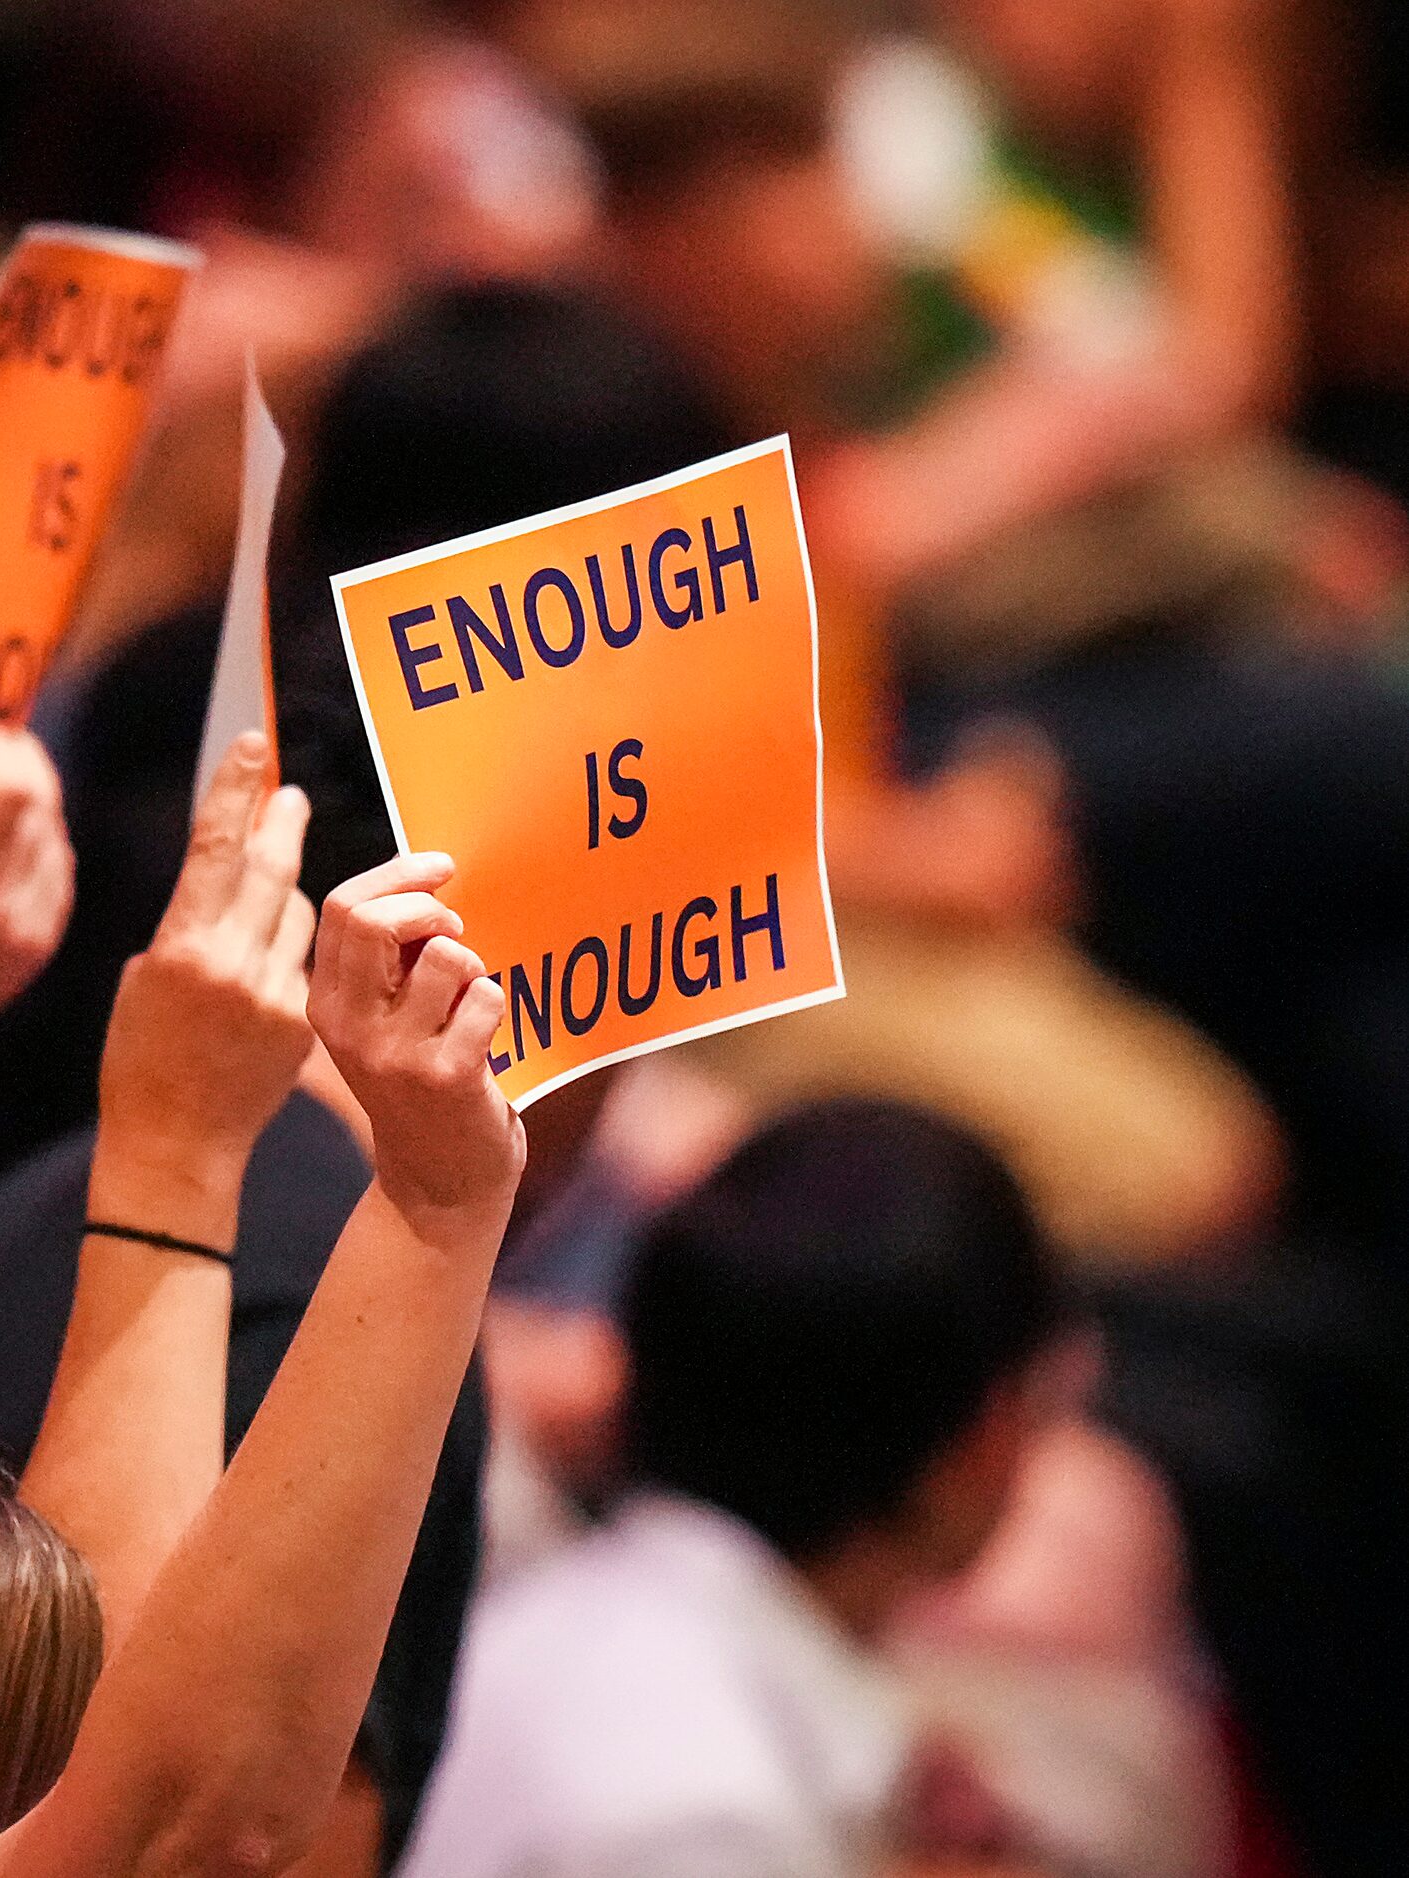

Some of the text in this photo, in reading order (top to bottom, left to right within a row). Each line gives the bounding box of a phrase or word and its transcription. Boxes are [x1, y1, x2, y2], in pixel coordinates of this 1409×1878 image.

[29, 458, 80, 552] IS
[388, 505, 760, 711] ENOUGH
[585, 738, 648, 850] IS
